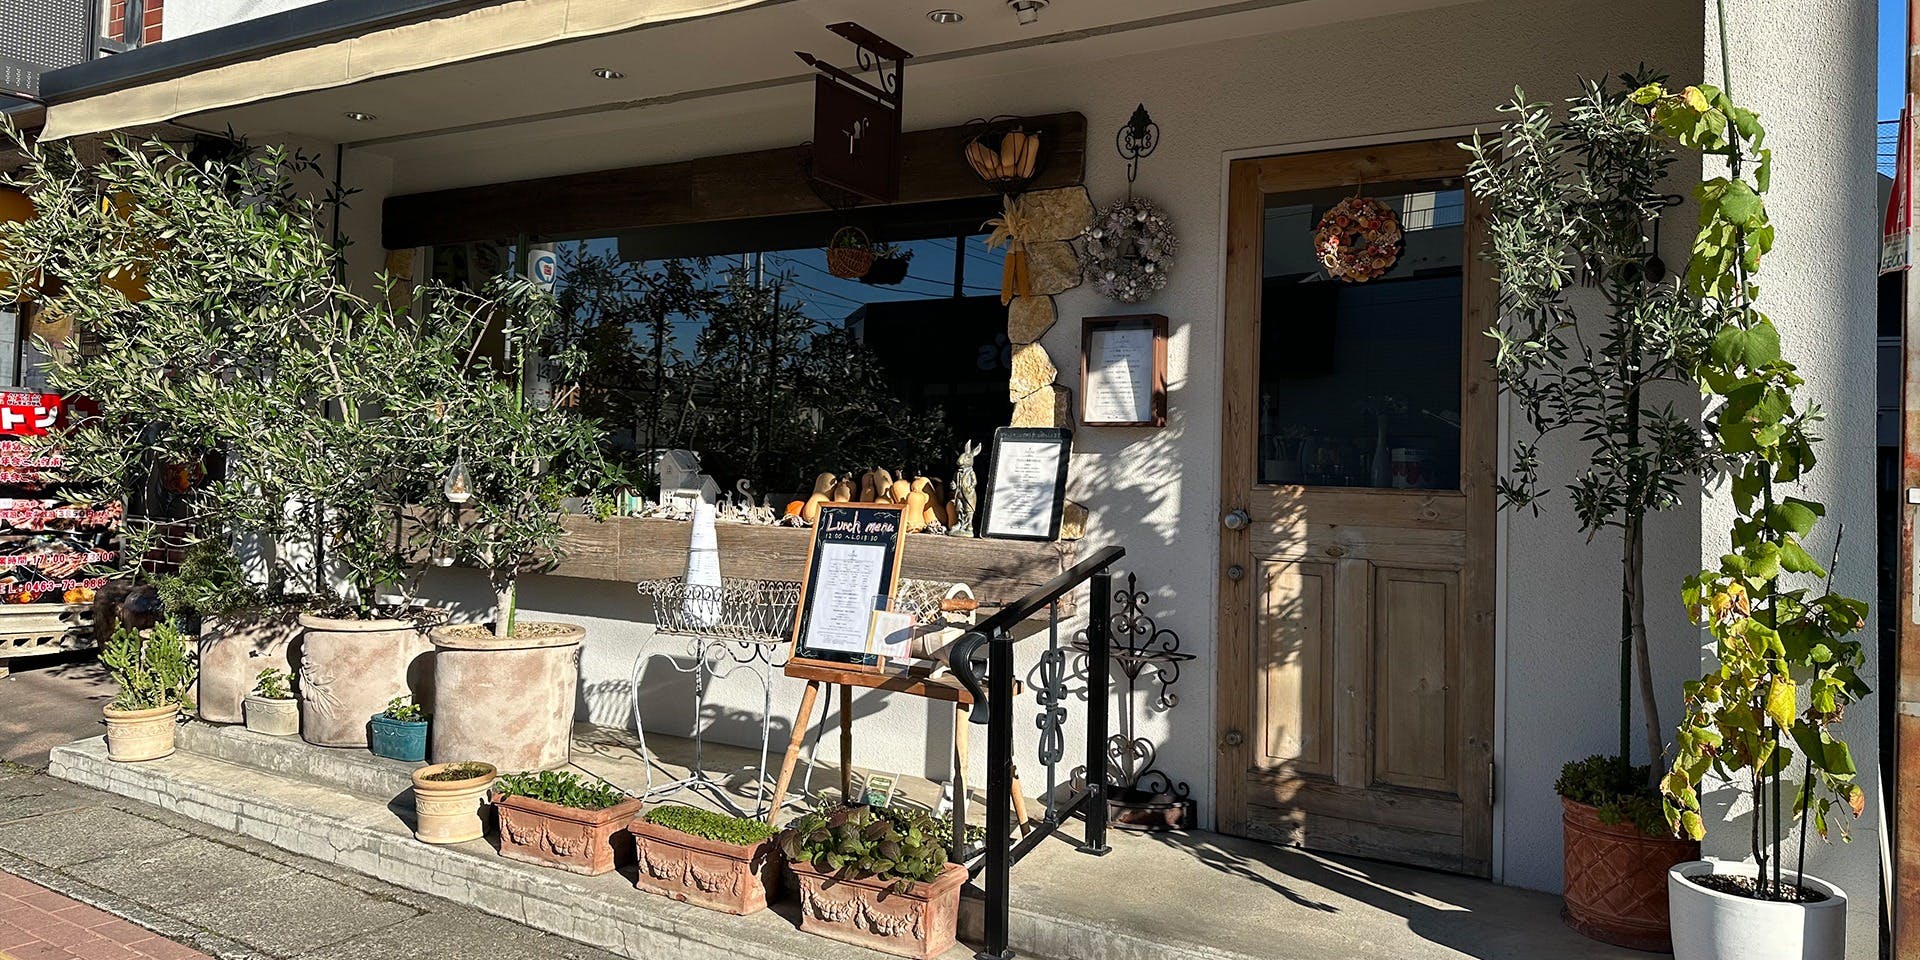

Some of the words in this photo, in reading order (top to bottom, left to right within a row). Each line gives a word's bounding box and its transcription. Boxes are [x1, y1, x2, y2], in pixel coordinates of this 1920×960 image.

[1, 405, 58, 430] トン
[826, 510, 861, 534] Lunch
[865, 522, 894, 534] menu
